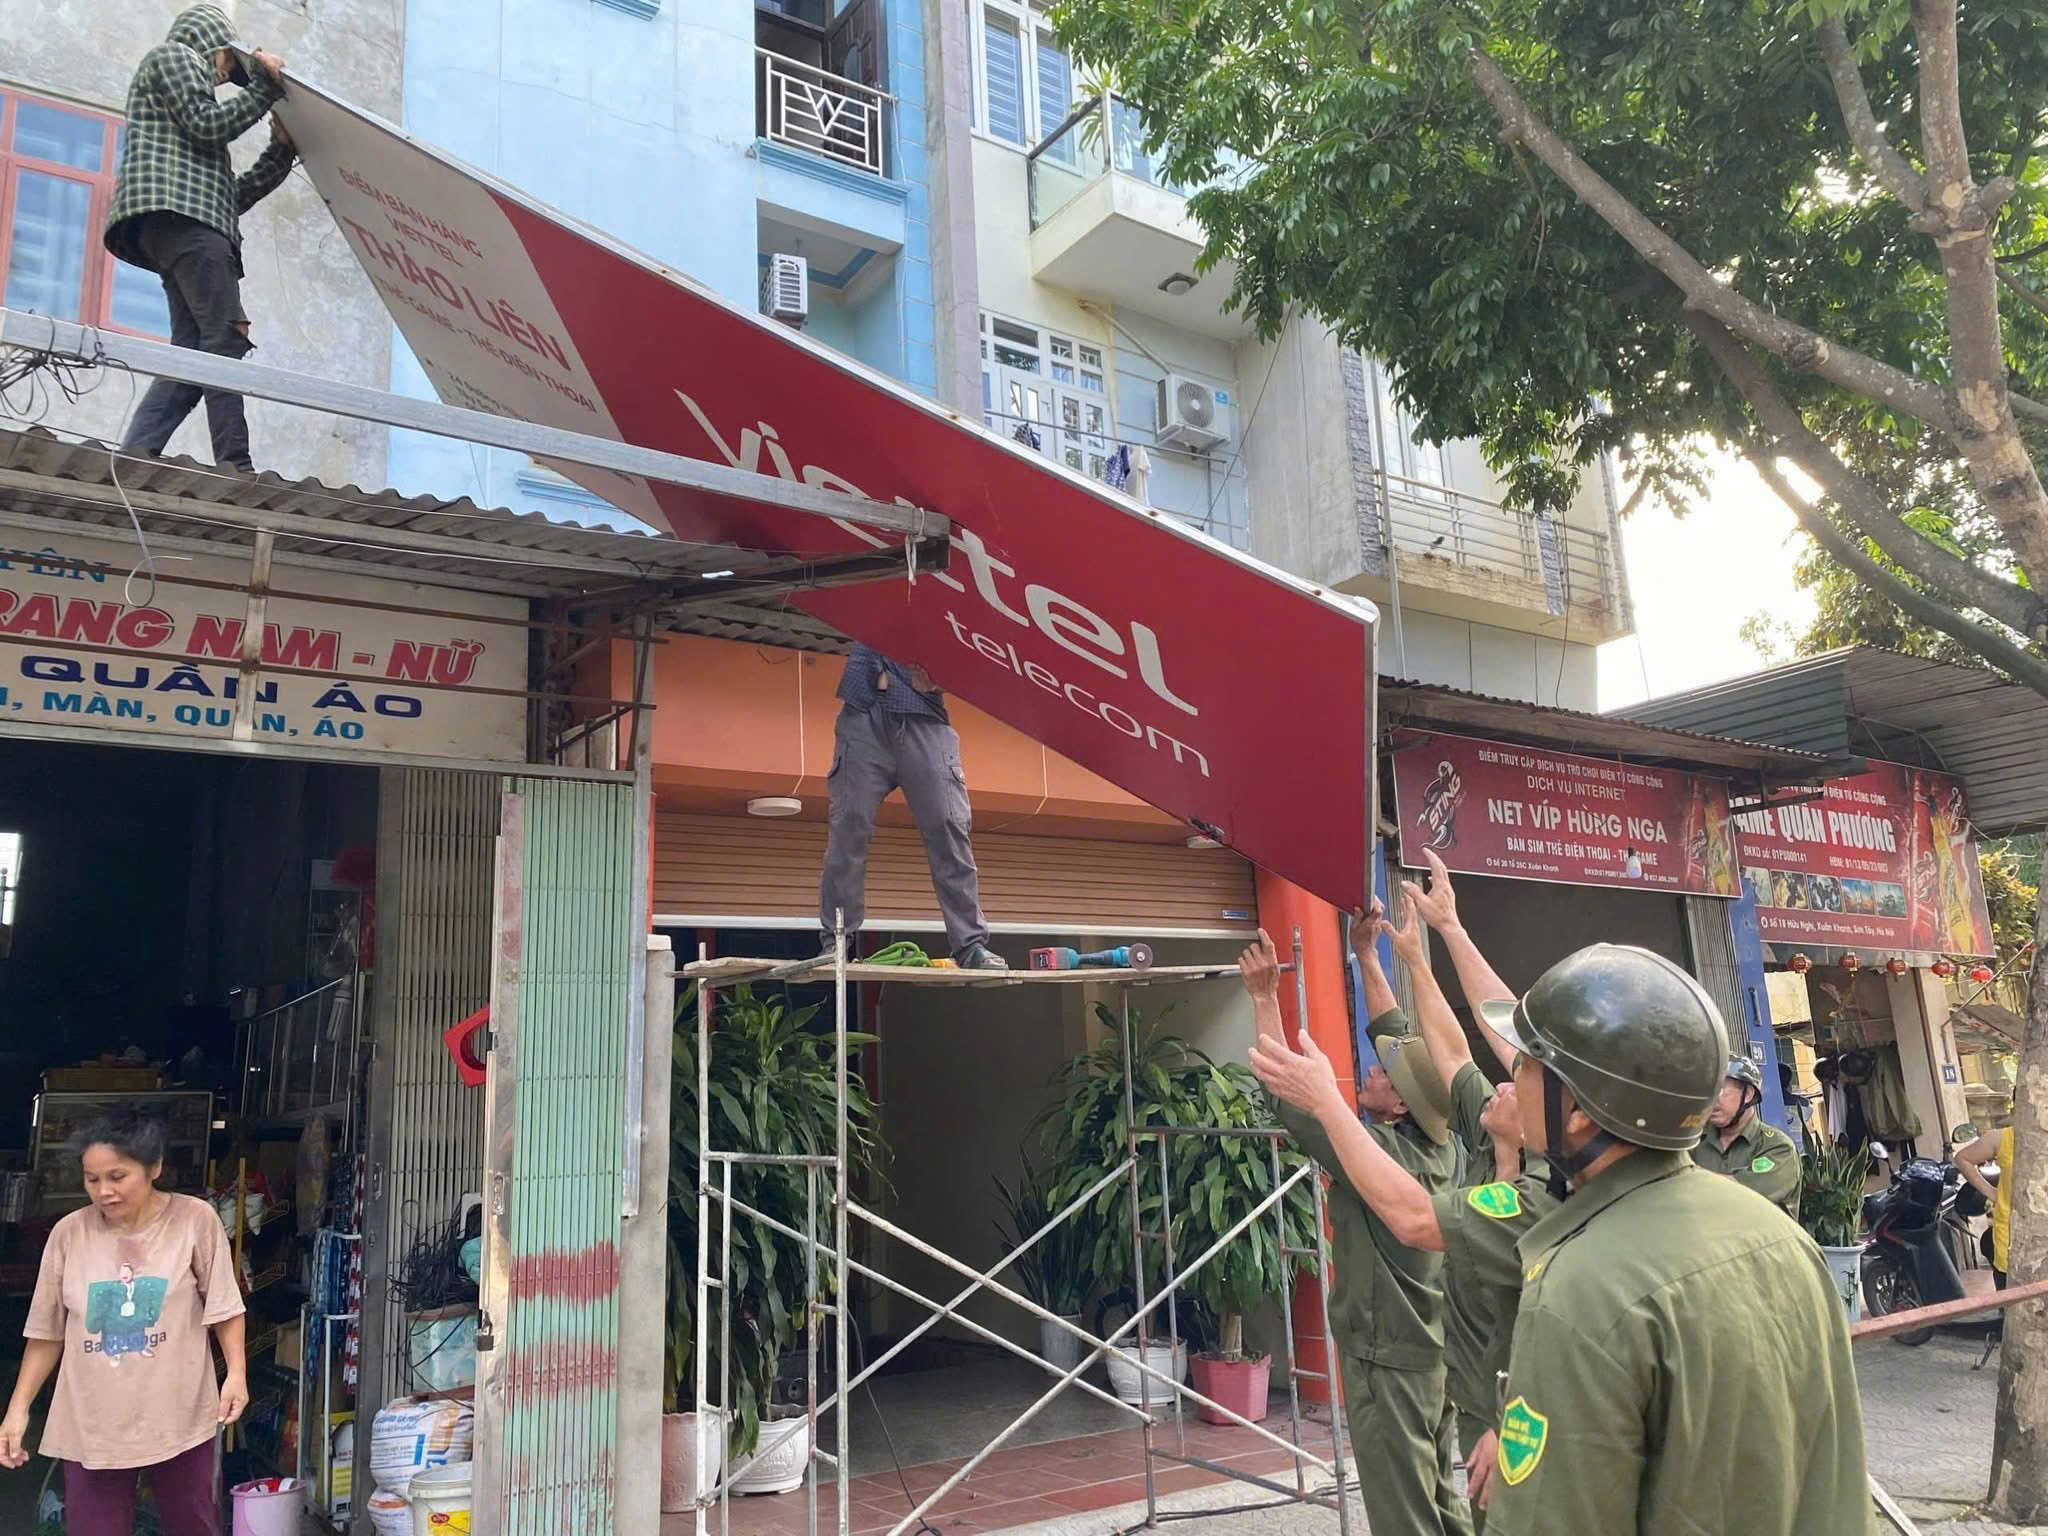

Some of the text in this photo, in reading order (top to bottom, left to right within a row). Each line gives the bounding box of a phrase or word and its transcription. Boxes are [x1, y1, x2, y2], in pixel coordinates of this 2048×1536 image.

[384, 213, 464, 267] VIETTEL
[342, 216, 572, 371] THẢO LIÊN
[673, 388, 1199, 717] Vietel
[385, 637, 485, 686] NỮ
[43, 691, 157, 723] MÀN,
[174, 704, 298, 737] QUN,
[313, 715, 364, 740] ÁO
[311, 681, 422, 718] ÁO
[944, 611, 1210, 778] telecom
[1500, 753, 1520, 766] TRUY
[1537, 758, 1554, 773] DỊCH
[1555, 761, 1566, 775] VỤ
[1527, 775, 1626, 801] DỊCH VỤ INTERNET
[1487, 798, 1523, 826] NET
[1528, 799, 1561, 831] VÍP
[1567, 804, 1623, 838] HÙNG
[1627, 816, 1669, 844] NGA
[1777, 802, 1827, 844] QUÂN
[1827, 809, 1897, 853] PHƯƠNG
[1506, 834, 1526, 852] BÁN
[1527, 838, 1544, 854] SIM
[1565, 844, 1585, 860] ĐIỆN
[1586, 846, 1611, 863] THOẠI
